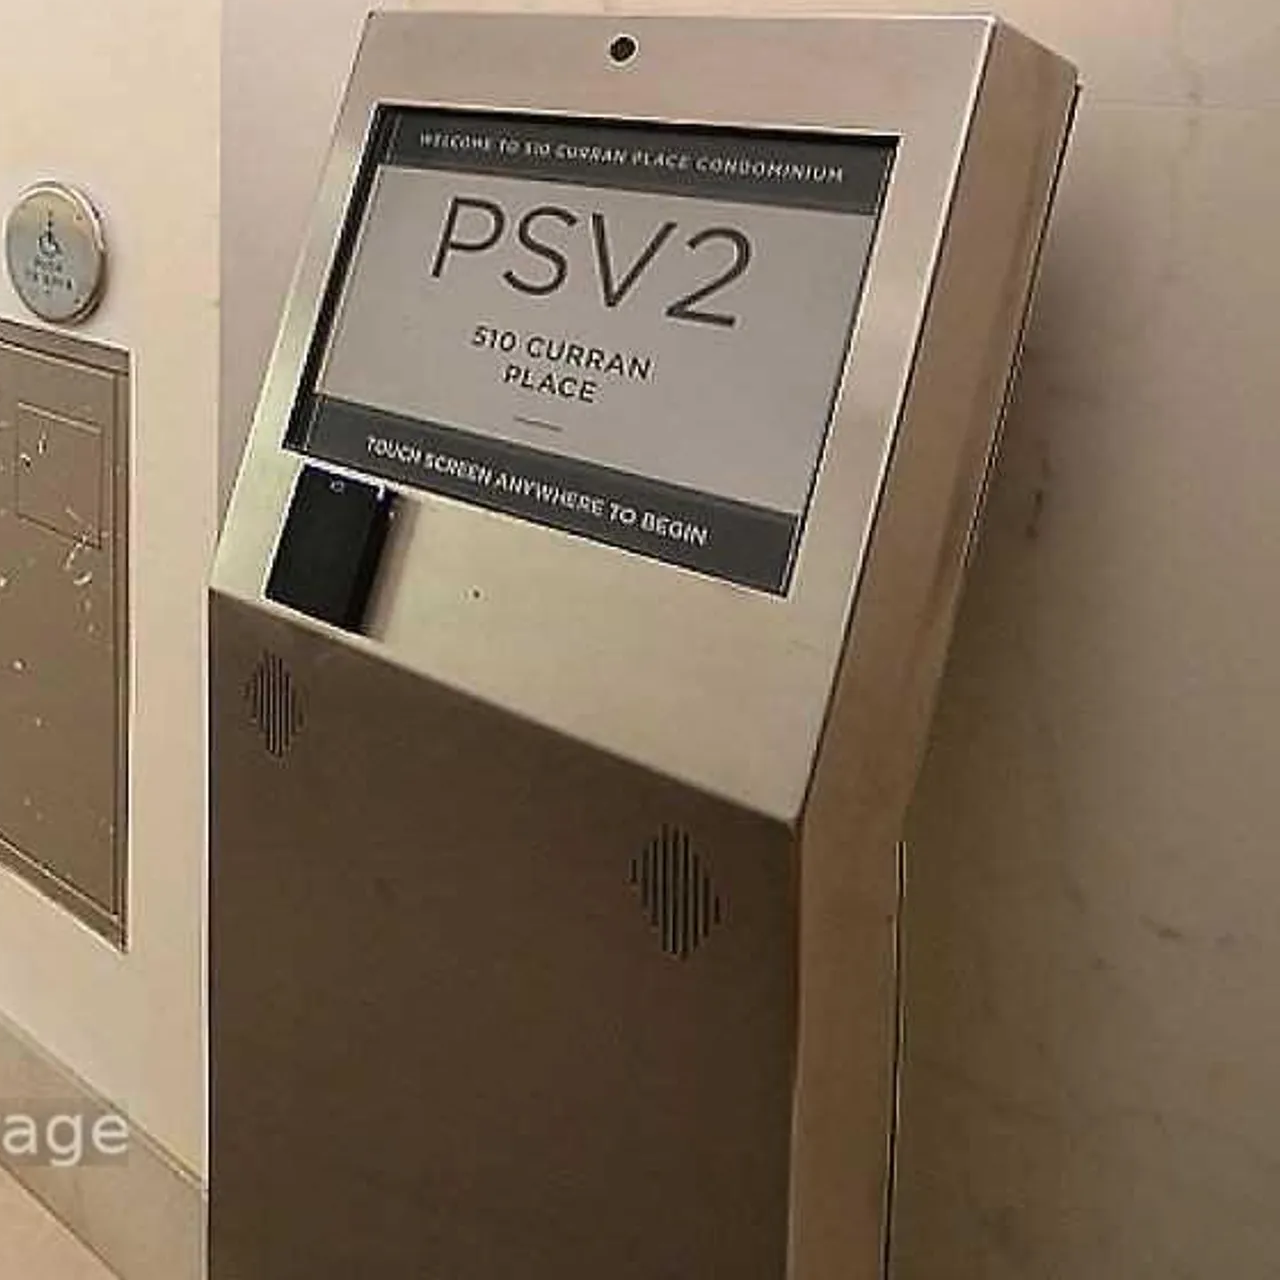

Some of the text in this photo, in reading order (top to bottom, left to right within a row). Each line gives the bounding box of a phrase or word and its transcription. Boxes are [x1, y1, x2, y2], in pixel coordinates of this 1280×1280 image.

[419, 132, 844, 183] WELCOME TO 510 CURRAN PLACE CONDOMINIUM
[429, 195, 753, 329] PSV2
[472, 324, 652, 380] 510 CURRAN
[503, 364, 598, 403] PLACE
[366, 435, 710, 546] TOUCH SCREEN ANYWHERE TO BEGIN
